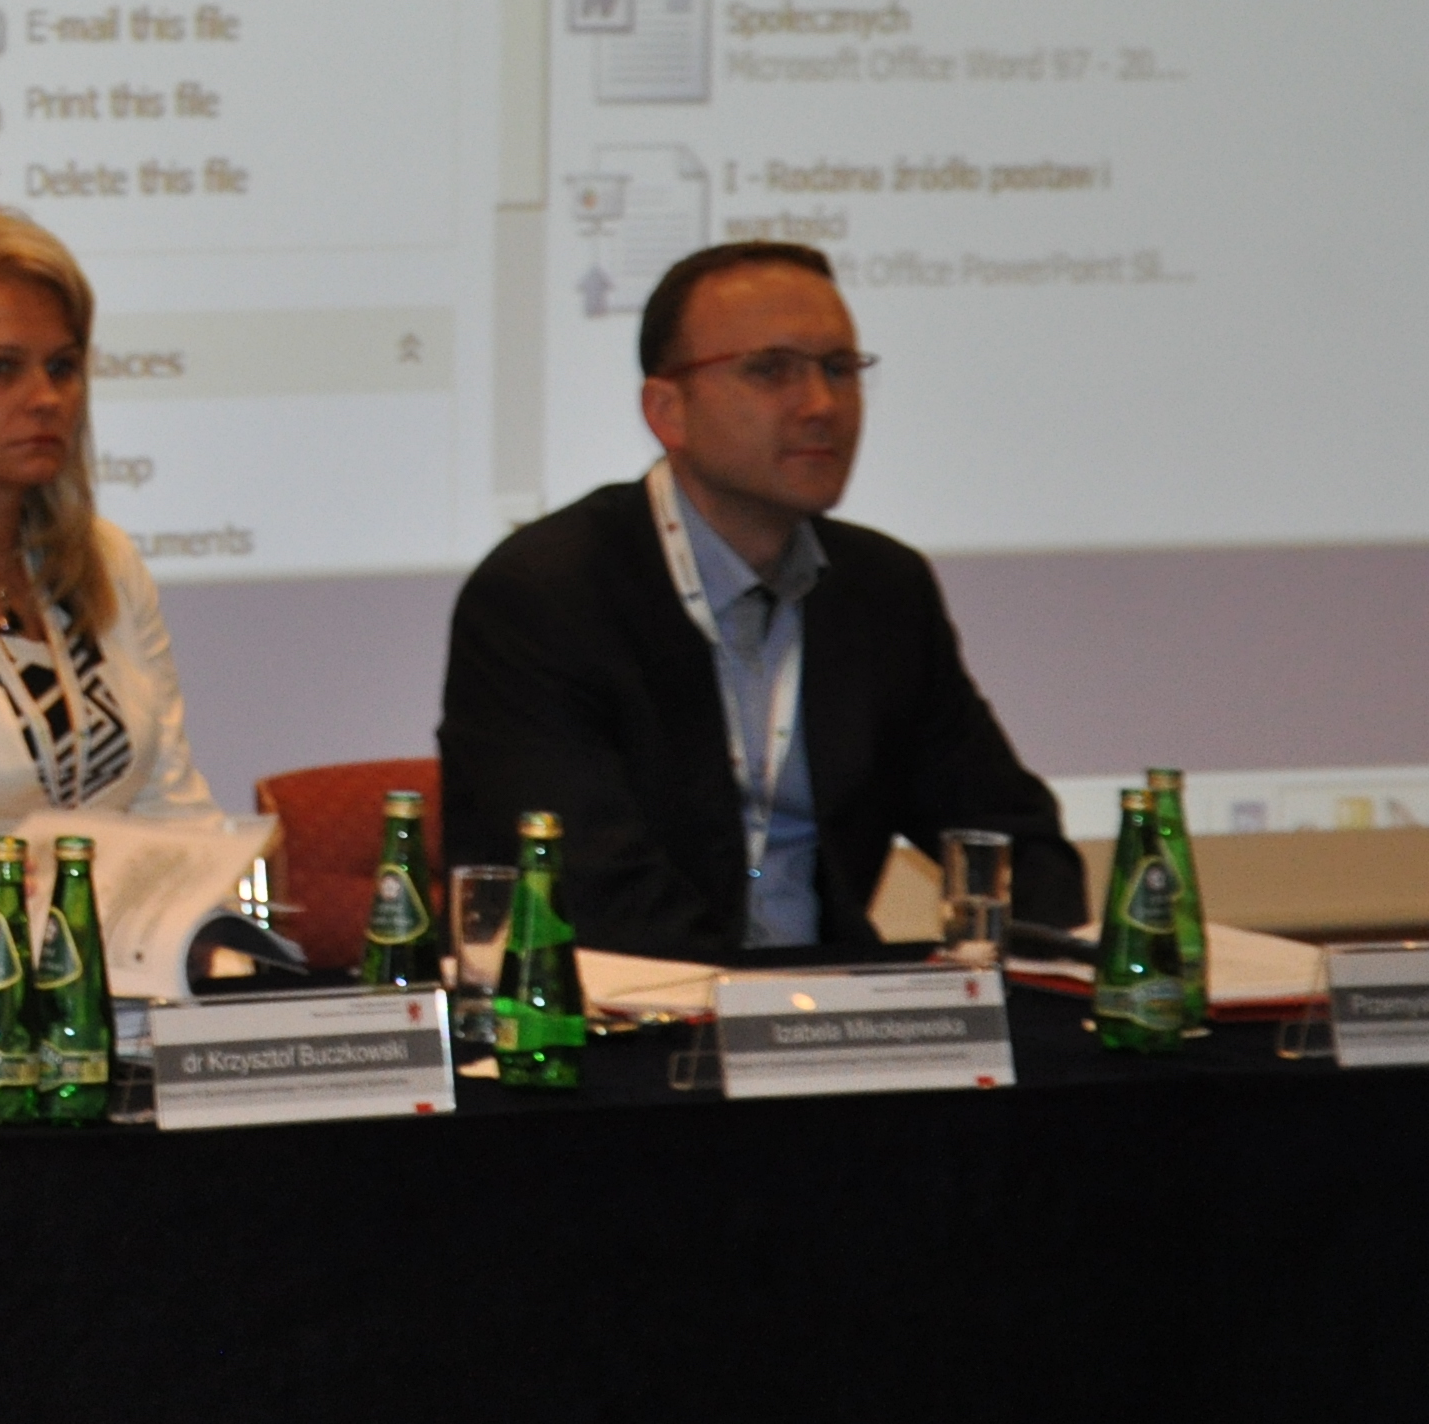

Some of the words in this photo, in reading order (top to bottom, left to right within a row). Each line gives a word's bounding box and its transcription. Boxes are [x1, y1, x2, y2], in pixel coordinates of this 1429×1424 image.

[27, 7, 120, 45] E-mail
[131, 6, 186, 43] this
[195, 5, 241, 42] file
[27, 84, 100, 121] Print
[110, 83, 166, 120] this
[175, 82, 221, 119] file
[27, 161, 129, 200] Delete
[140, 160, 196, 197] this
[204, 159, 250, 196] file
[181, 1053, 204, 1074] dr
[206, 1046, 295, 1075] Krzysztof
[298, 1039, 409, 1067] Buczkowski
